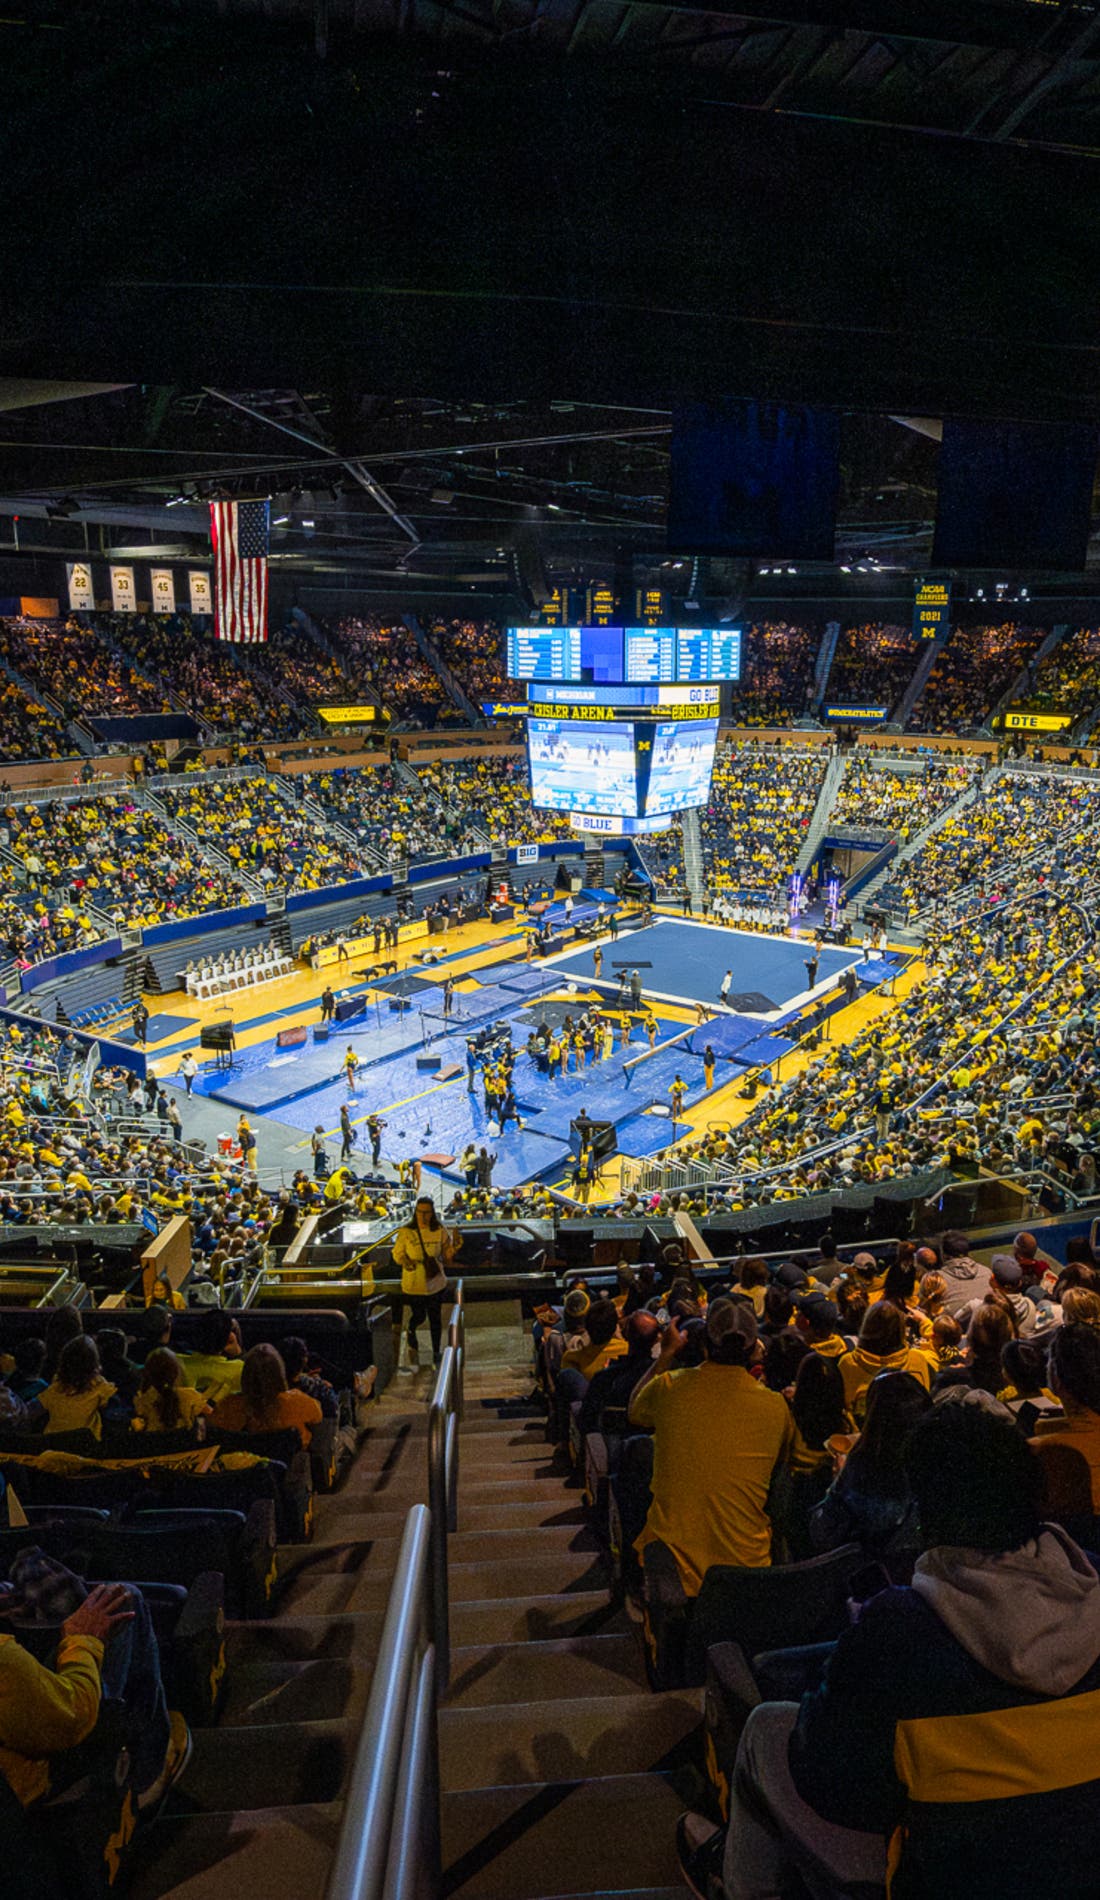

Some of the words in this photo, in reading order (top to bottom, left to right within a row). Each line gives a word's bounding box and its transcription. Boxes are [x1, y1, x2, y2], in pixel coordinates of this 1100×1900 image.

[74, 578, 86, 588] 22
[118, 580, 128, 590] 33
[157, 582, 168, 592] 45
[196, 584, 206, 593] 35
[920, 611, 941, 622] 2021
[922, 628, 936, 638] M
[571, 706, 615, 720] ARENA
[1012, 717, 1037, 726] DTE
[638, 741, 650, 750] M
[583, 818, 612, 830] BLUE
[519, 847, 536, 857] BIG
